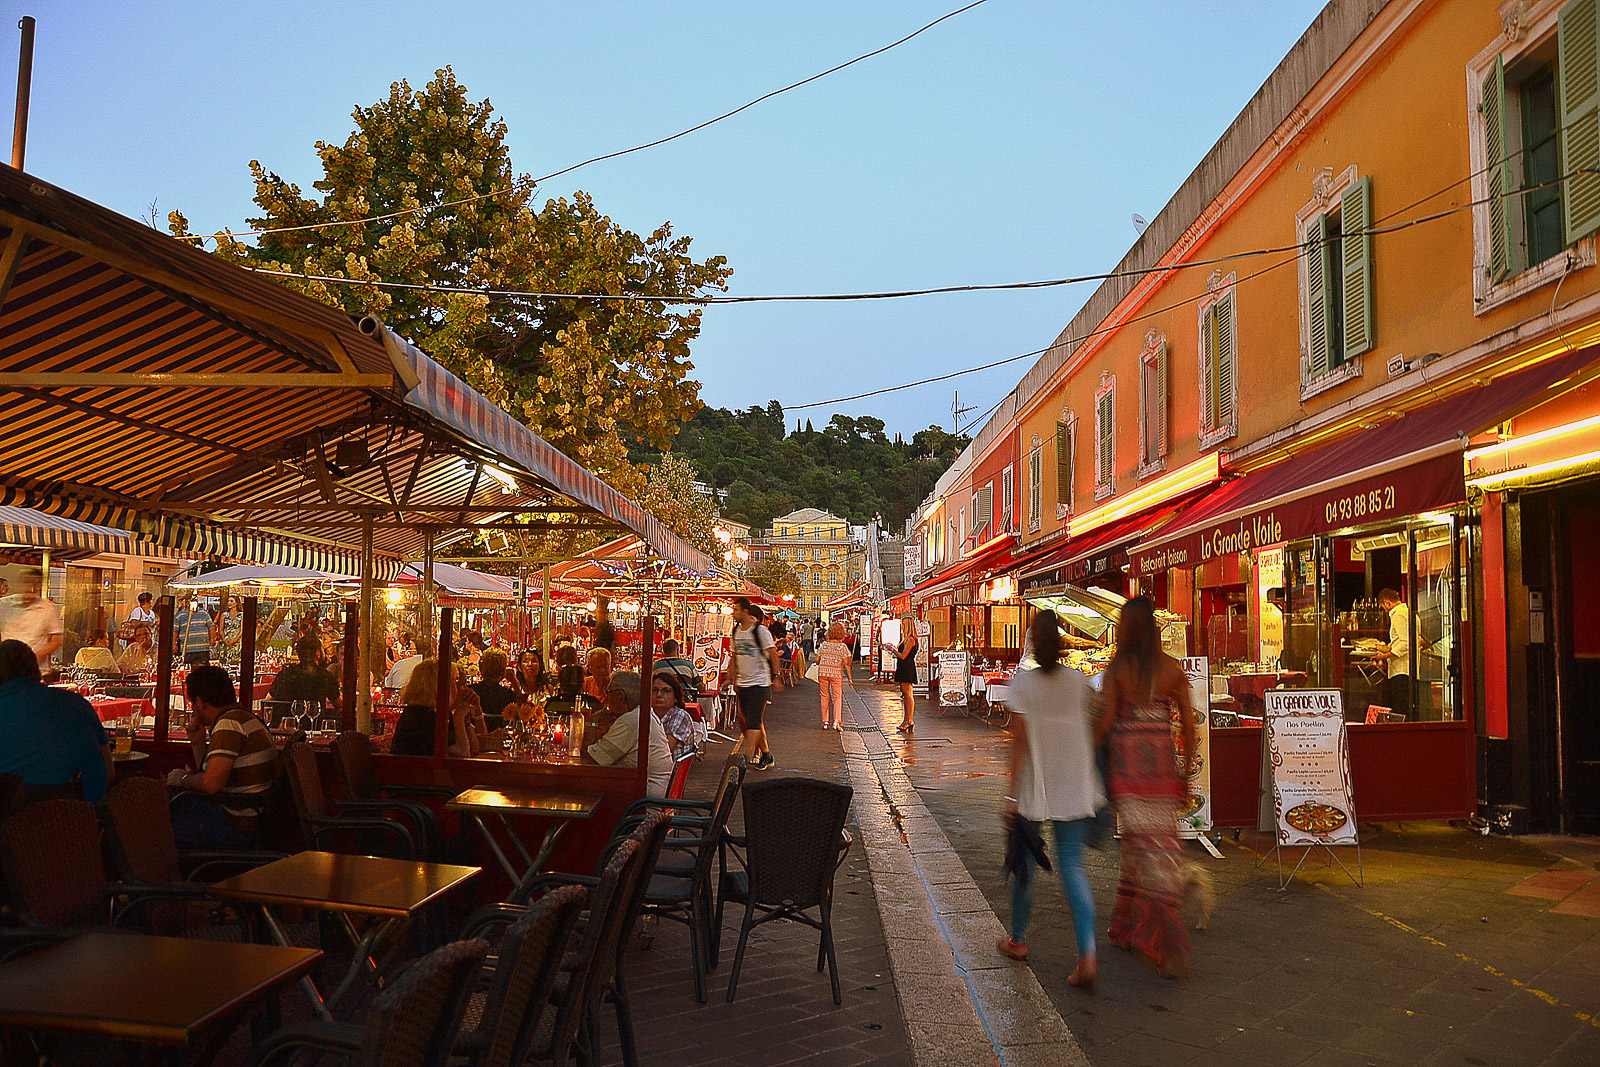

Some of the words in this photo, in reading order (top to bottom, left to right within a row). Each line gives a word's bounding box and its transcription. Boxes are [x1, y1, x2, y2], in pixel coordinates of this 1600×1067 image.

[1325, 500, 1338, 524] 04
[1339, 496, 1352, 520] 93
[1354, 493, 1366, 517] 88
[1368, 488, 1382, 514] 85
[1384, 485, 1395, 510] 21
[1200, 534, 1211, 560] La
[1212, 521, 1251, 556] Grande
[1252, 512, 1282, 547] Voile
[1271, 695, 1282, 710] LA
[1283, 695, 1314, 712] GRANDE
[1314, 695, 1337, 710] VOILE
